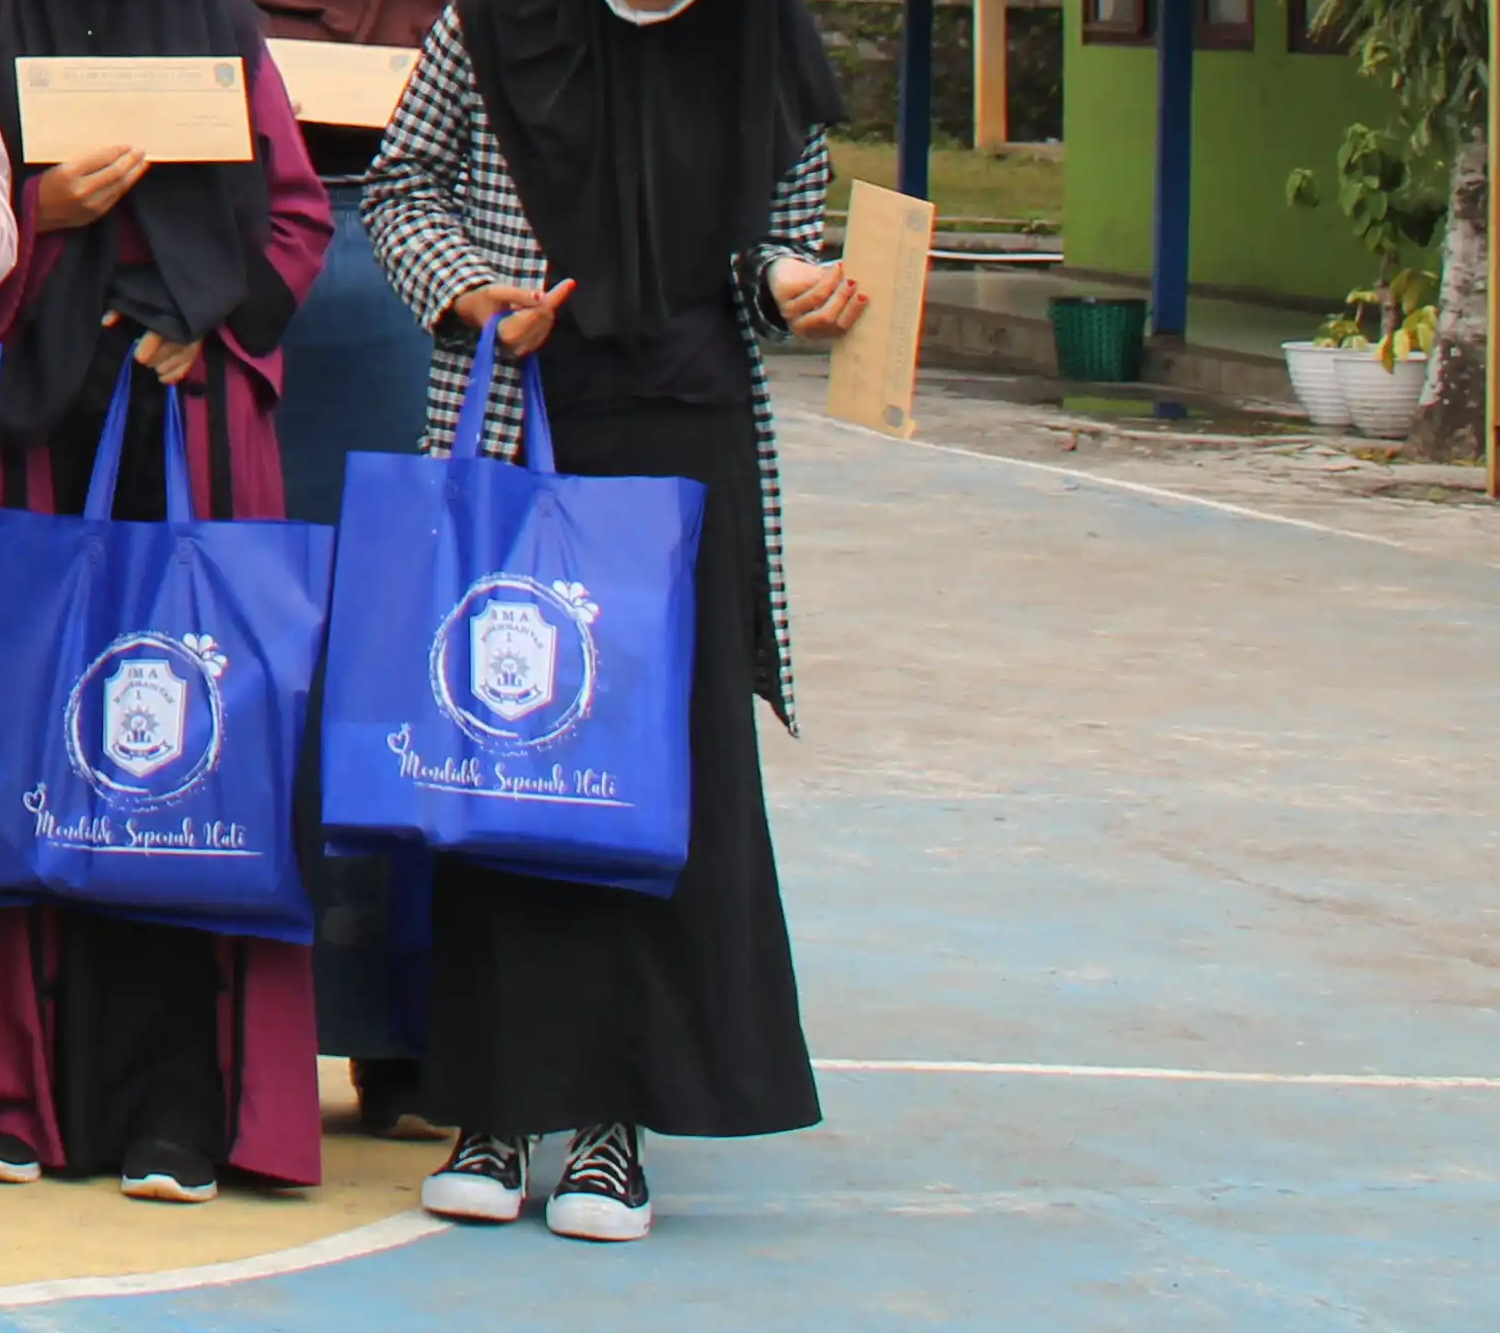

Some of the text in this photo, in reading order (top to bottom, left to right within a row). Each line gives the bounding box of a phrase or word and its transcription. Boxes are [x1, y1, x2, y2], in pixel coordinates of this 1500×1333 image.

[398, 751, 617, 801] Mendidik Sepenuh Hati
[35, 811, 245, 857] Mendidik Sepenuh Hati
